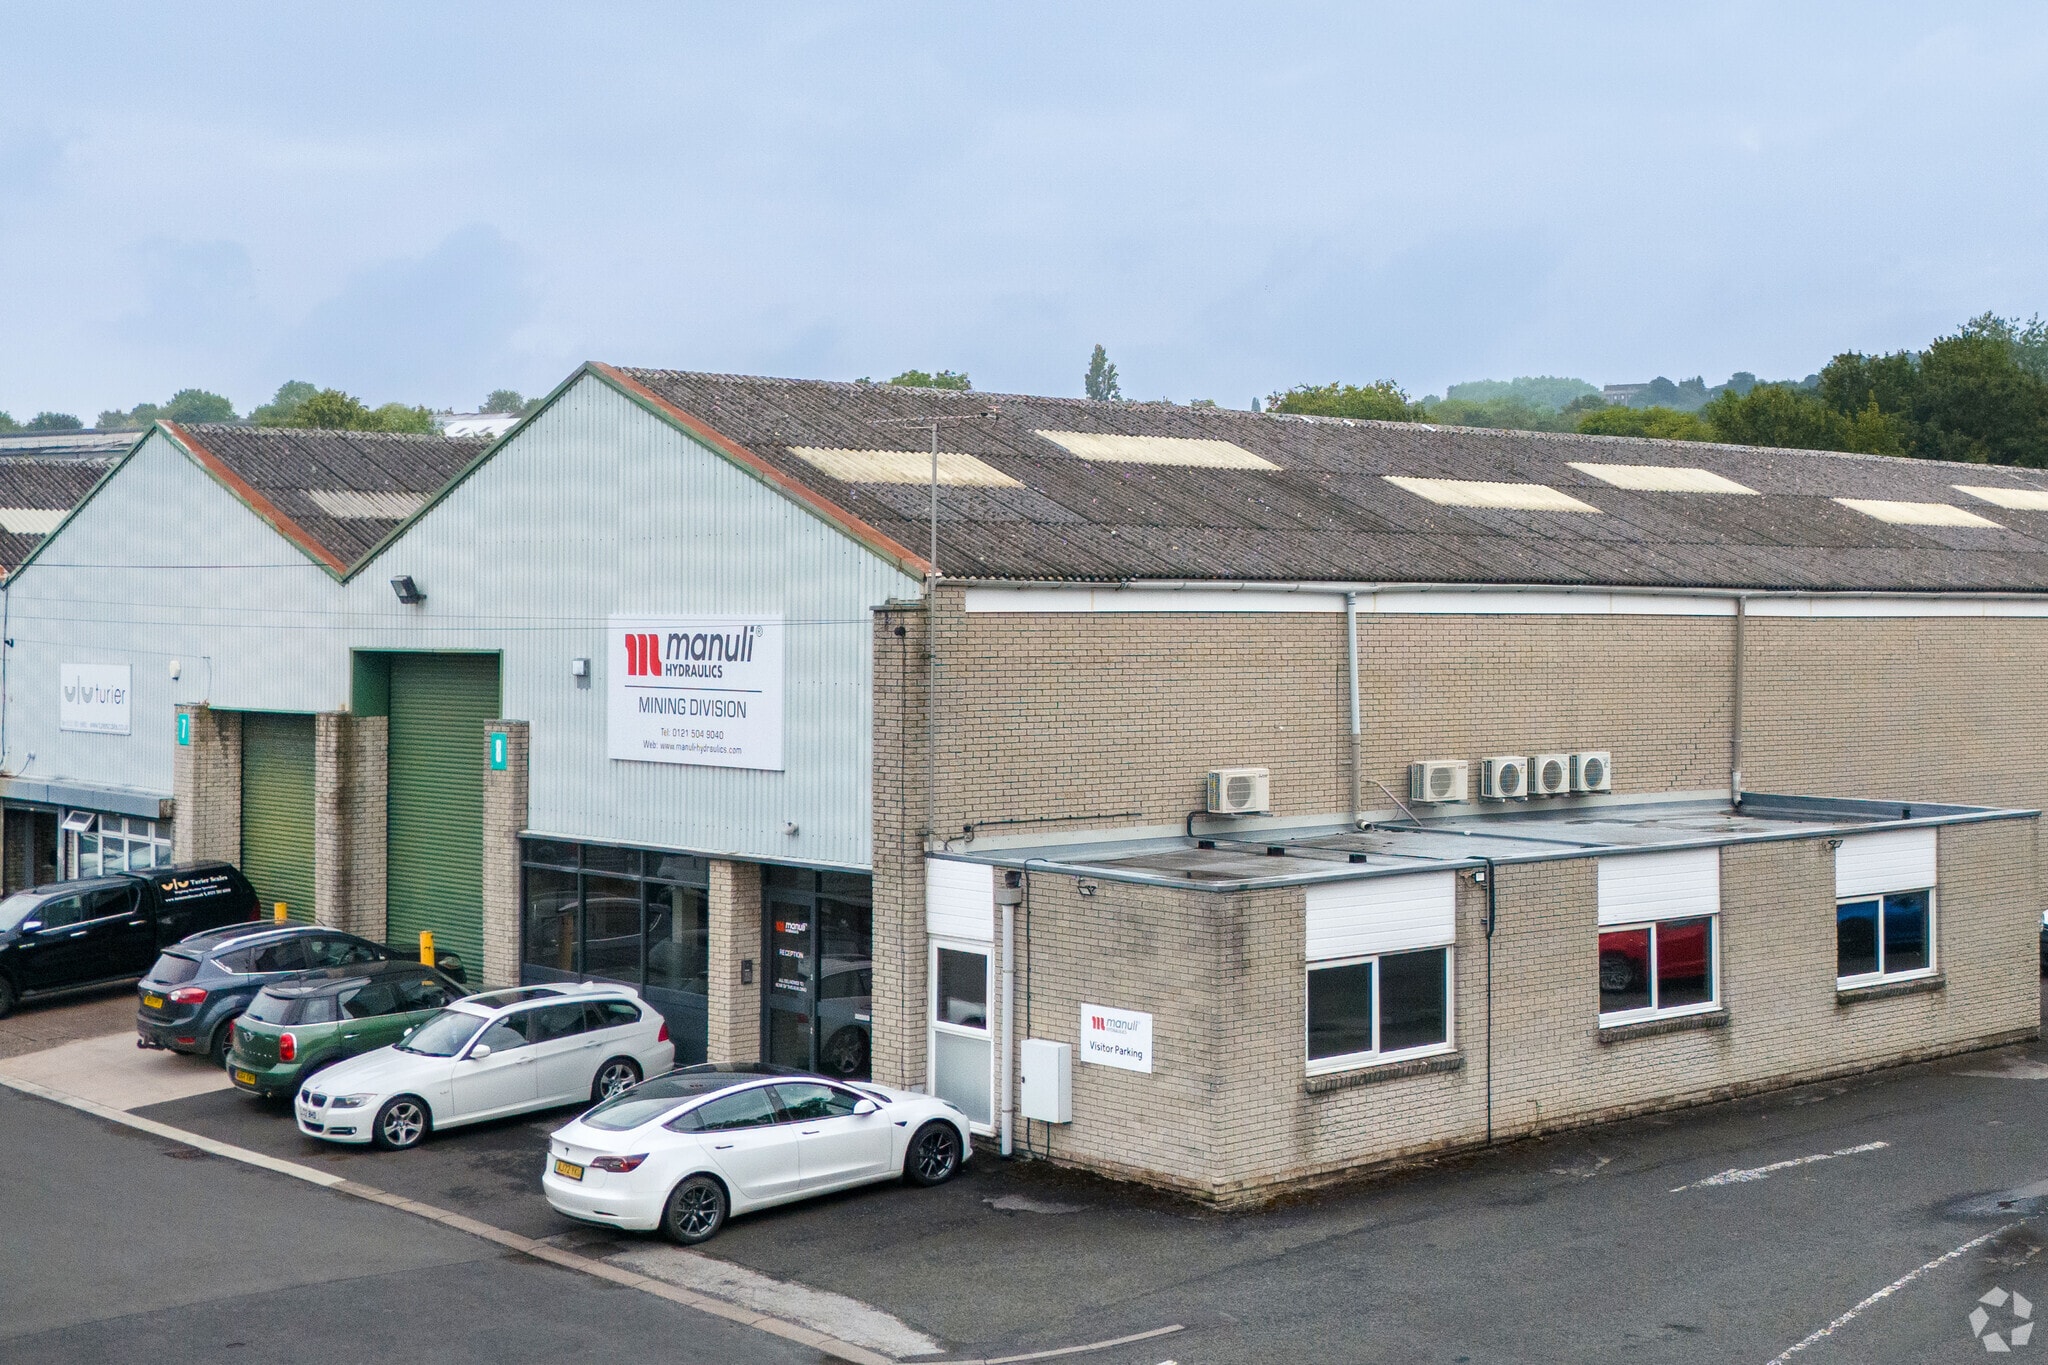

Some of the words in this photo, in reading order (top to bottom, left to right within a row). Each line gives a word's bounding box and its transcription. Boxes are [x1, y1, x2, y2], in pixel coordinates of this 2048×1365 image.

[665, 664, 723, 678] HYDRAULICS
[95, 683, 126, 705] turier
[639, 696, 686, 716] MINING
[690, 699, 747, 718] DIVISION
[672, 728, 689, 738] 0121
[691, 729, 704, 739] 504
[706, 730, 724, 740] 9040
[643, 739, 658, 750] Web:
[779, 948, 804, 959] RECEPTION
[1089, 1040, 1113, 1052] Visitor
[1115, 1045, 1143, 1061] Parking
